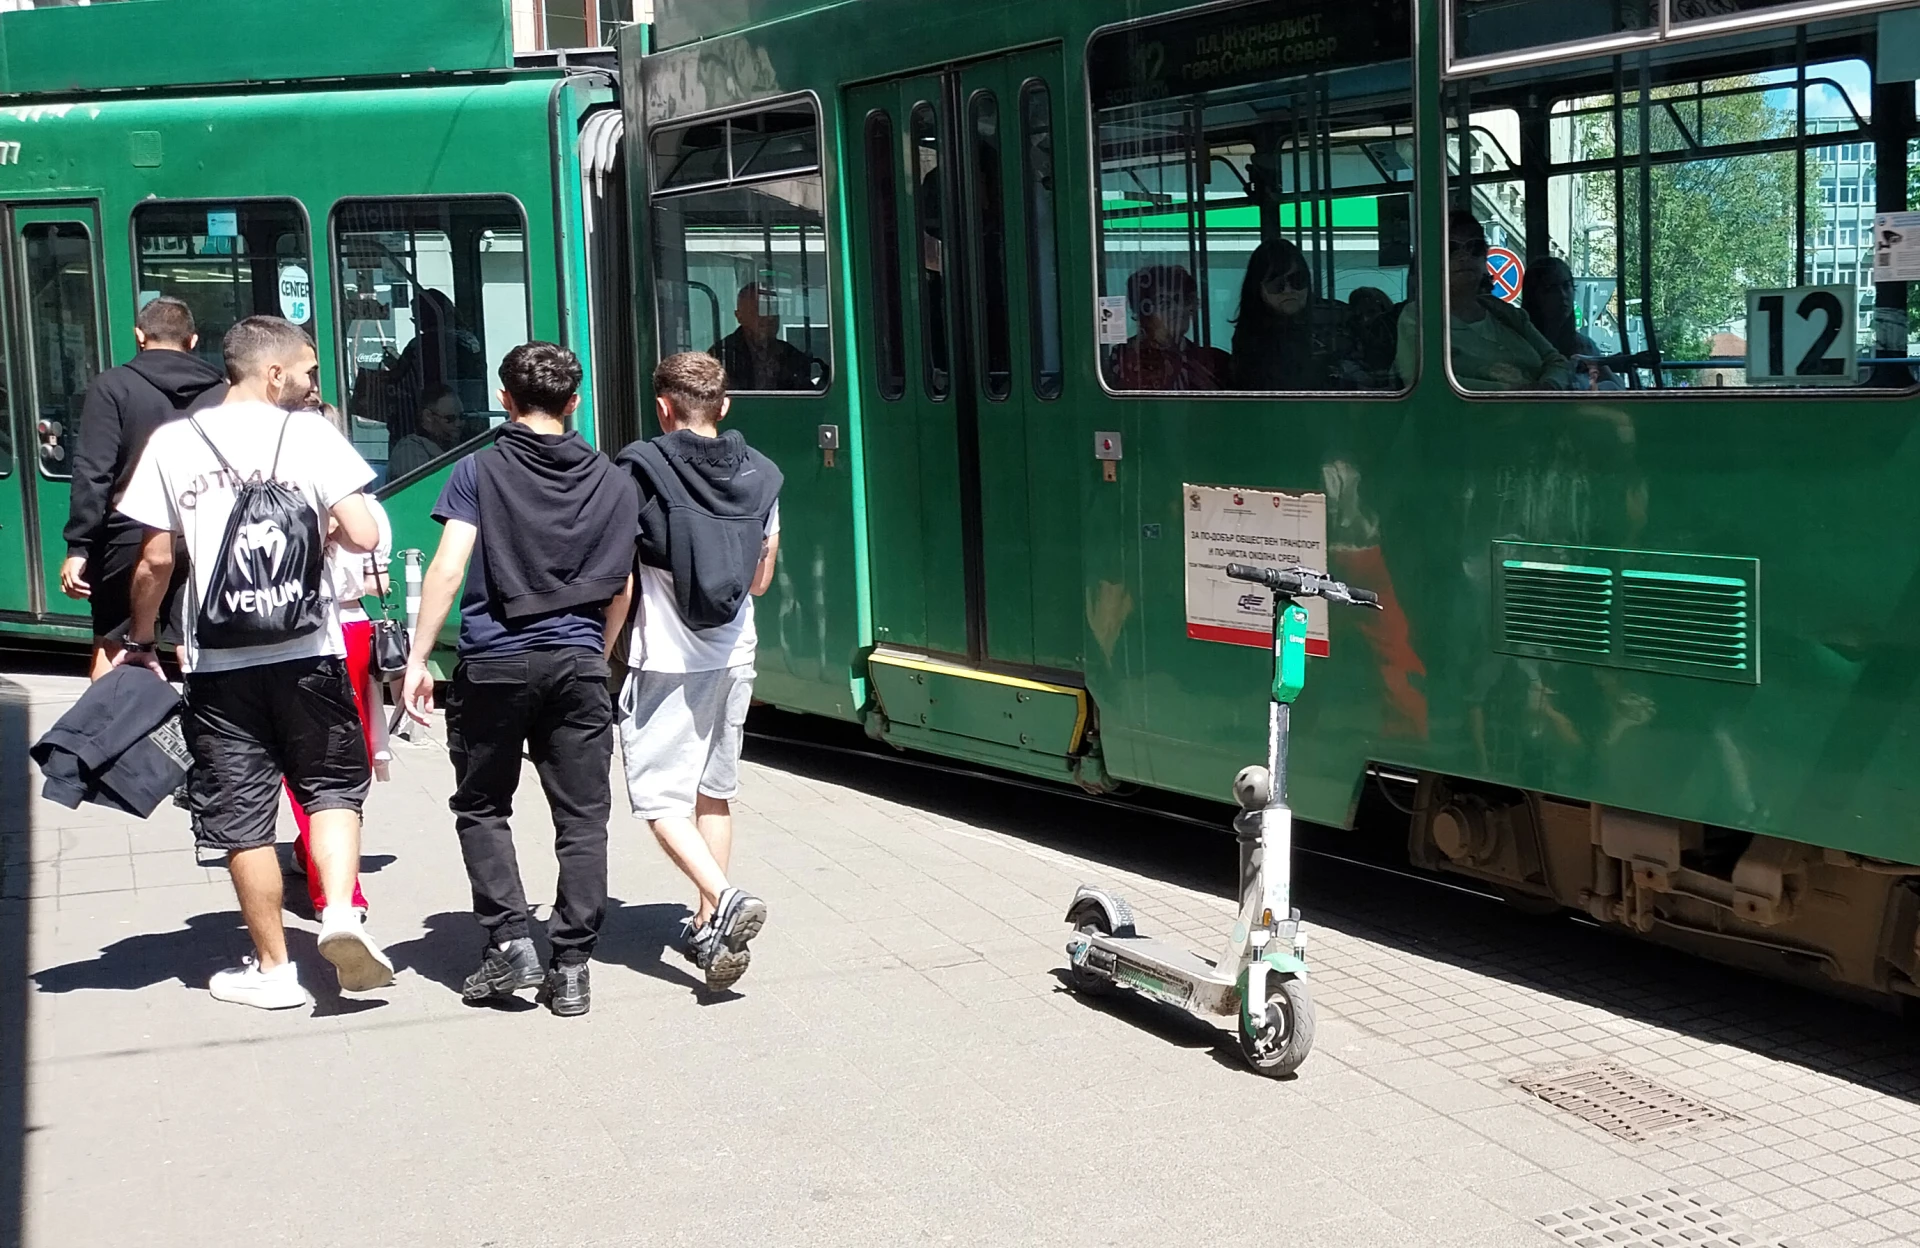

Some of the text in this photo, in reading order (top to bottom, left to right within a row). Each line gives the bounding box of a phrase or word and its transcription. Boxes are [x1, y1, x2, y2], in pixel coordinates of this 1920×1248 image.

[281, 280, 309, 297] CENTER
[291, 302, 305, 319] 16
[1757, 291, 1846, 376] 12
[1191, 531, 1199, 540] ЗА
[1236, 534, 1278, 546] ОБЩЕСТВЕН
[1280, 538, 1320, 550] ТРАНСПОРТ
[1215, 548, 1248, 559] ПО-ЧИСТА
[1249, 551, 1276, 561] ОКОЛНА
[1278, 553, 1301, 564] СРЕДА
[225, 579, 303, 617] VENUM
